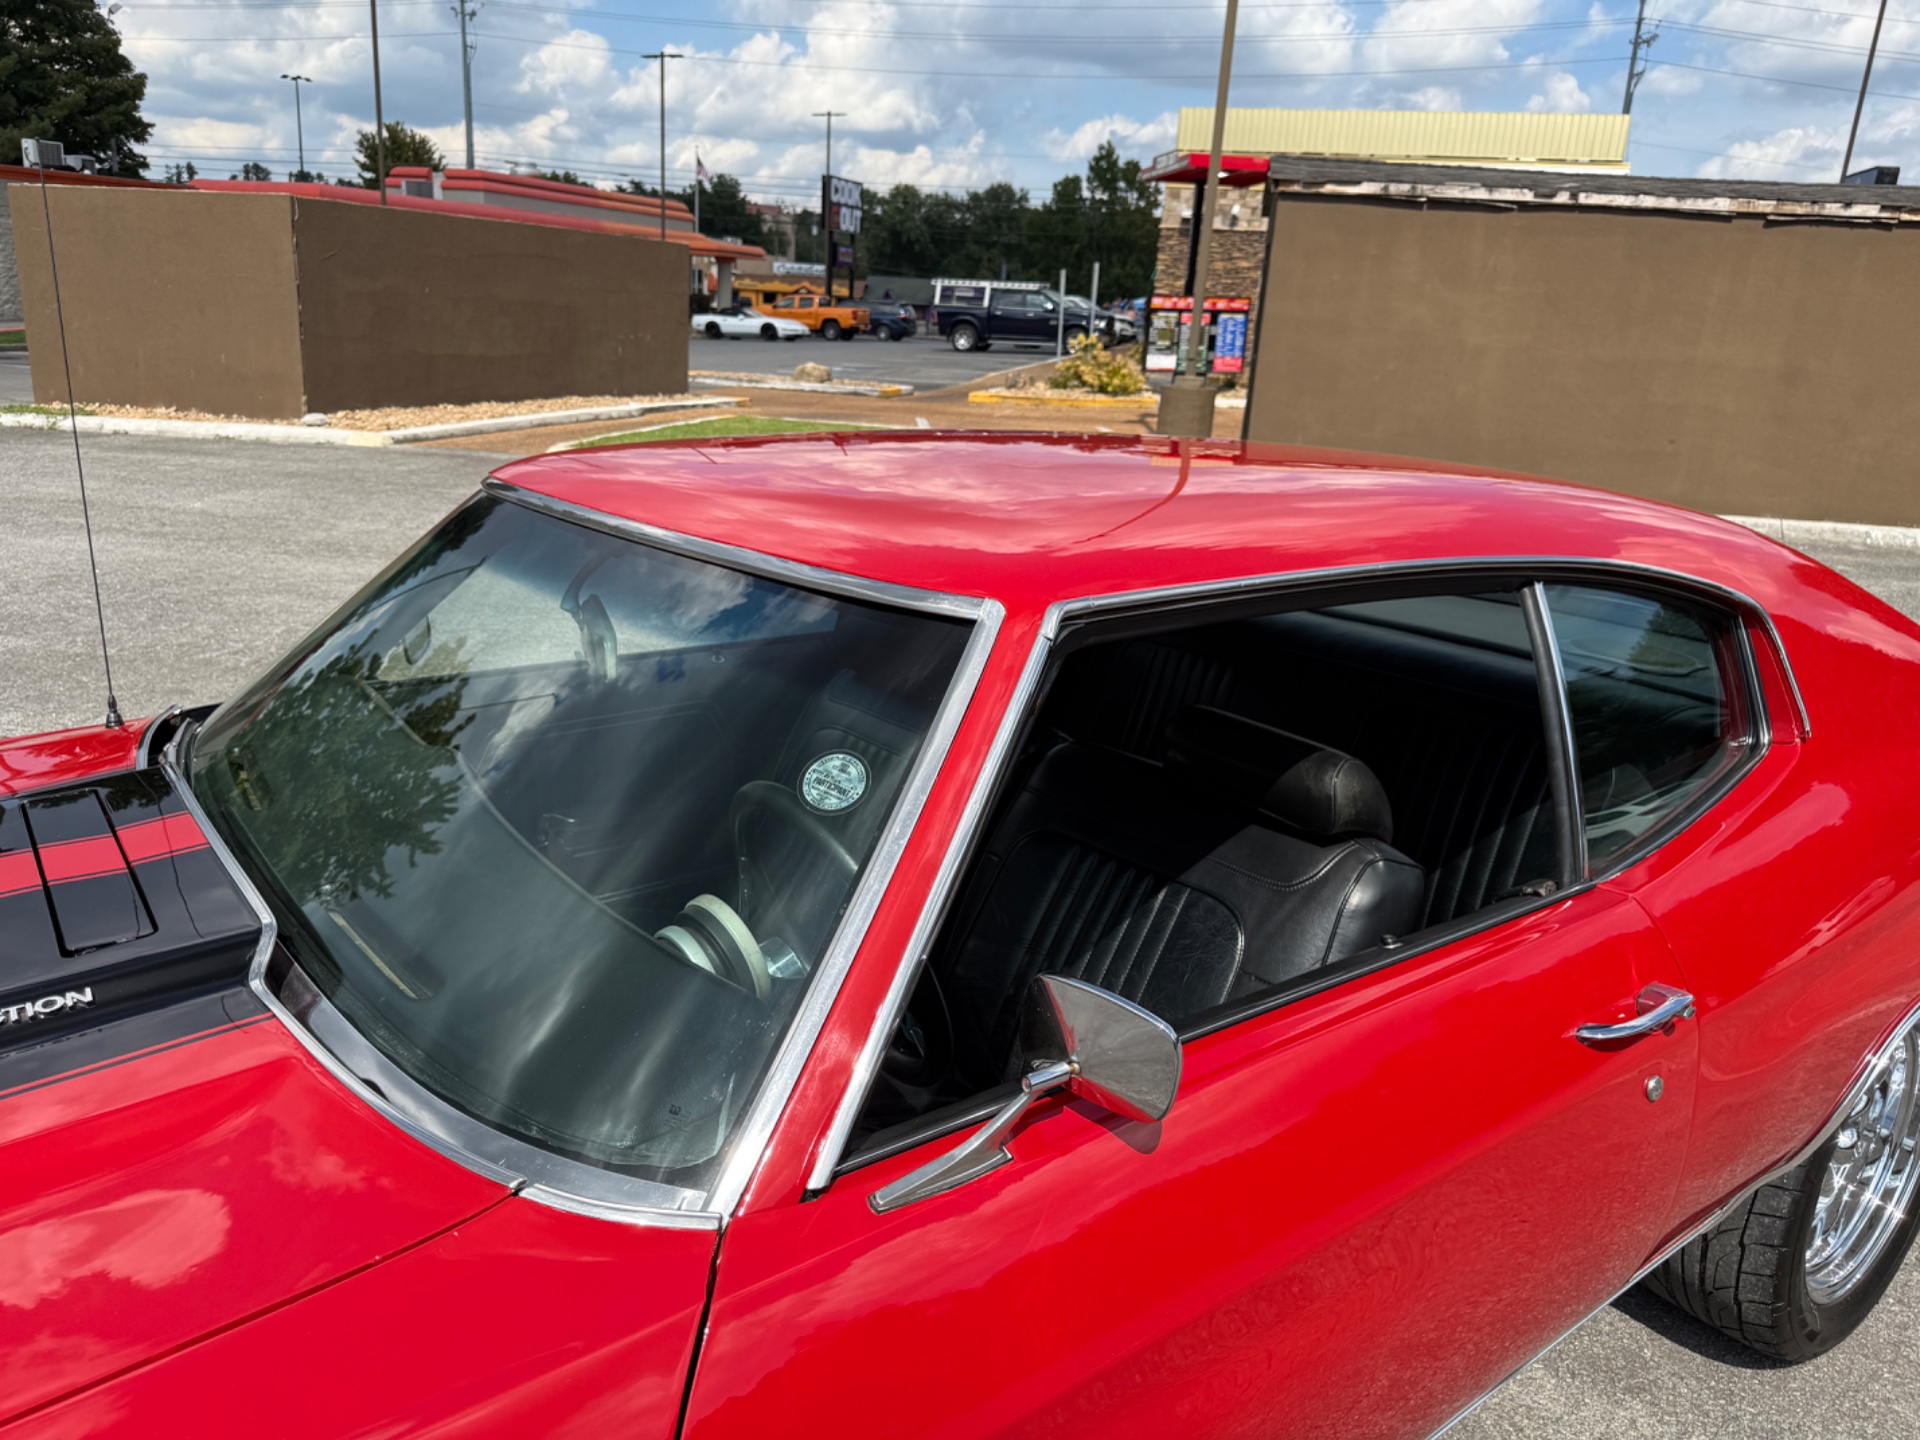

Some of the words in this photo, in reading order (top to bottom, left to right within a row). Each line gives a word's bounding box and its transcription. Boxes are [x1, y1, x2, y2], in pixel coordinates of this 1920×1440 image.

[831, 178, 862, 208] COOK
[840, 206, 862, 233] OUT
[812, 776, 852, 797] PARTICIPANT
[0, 987, 93, 1023] TION
